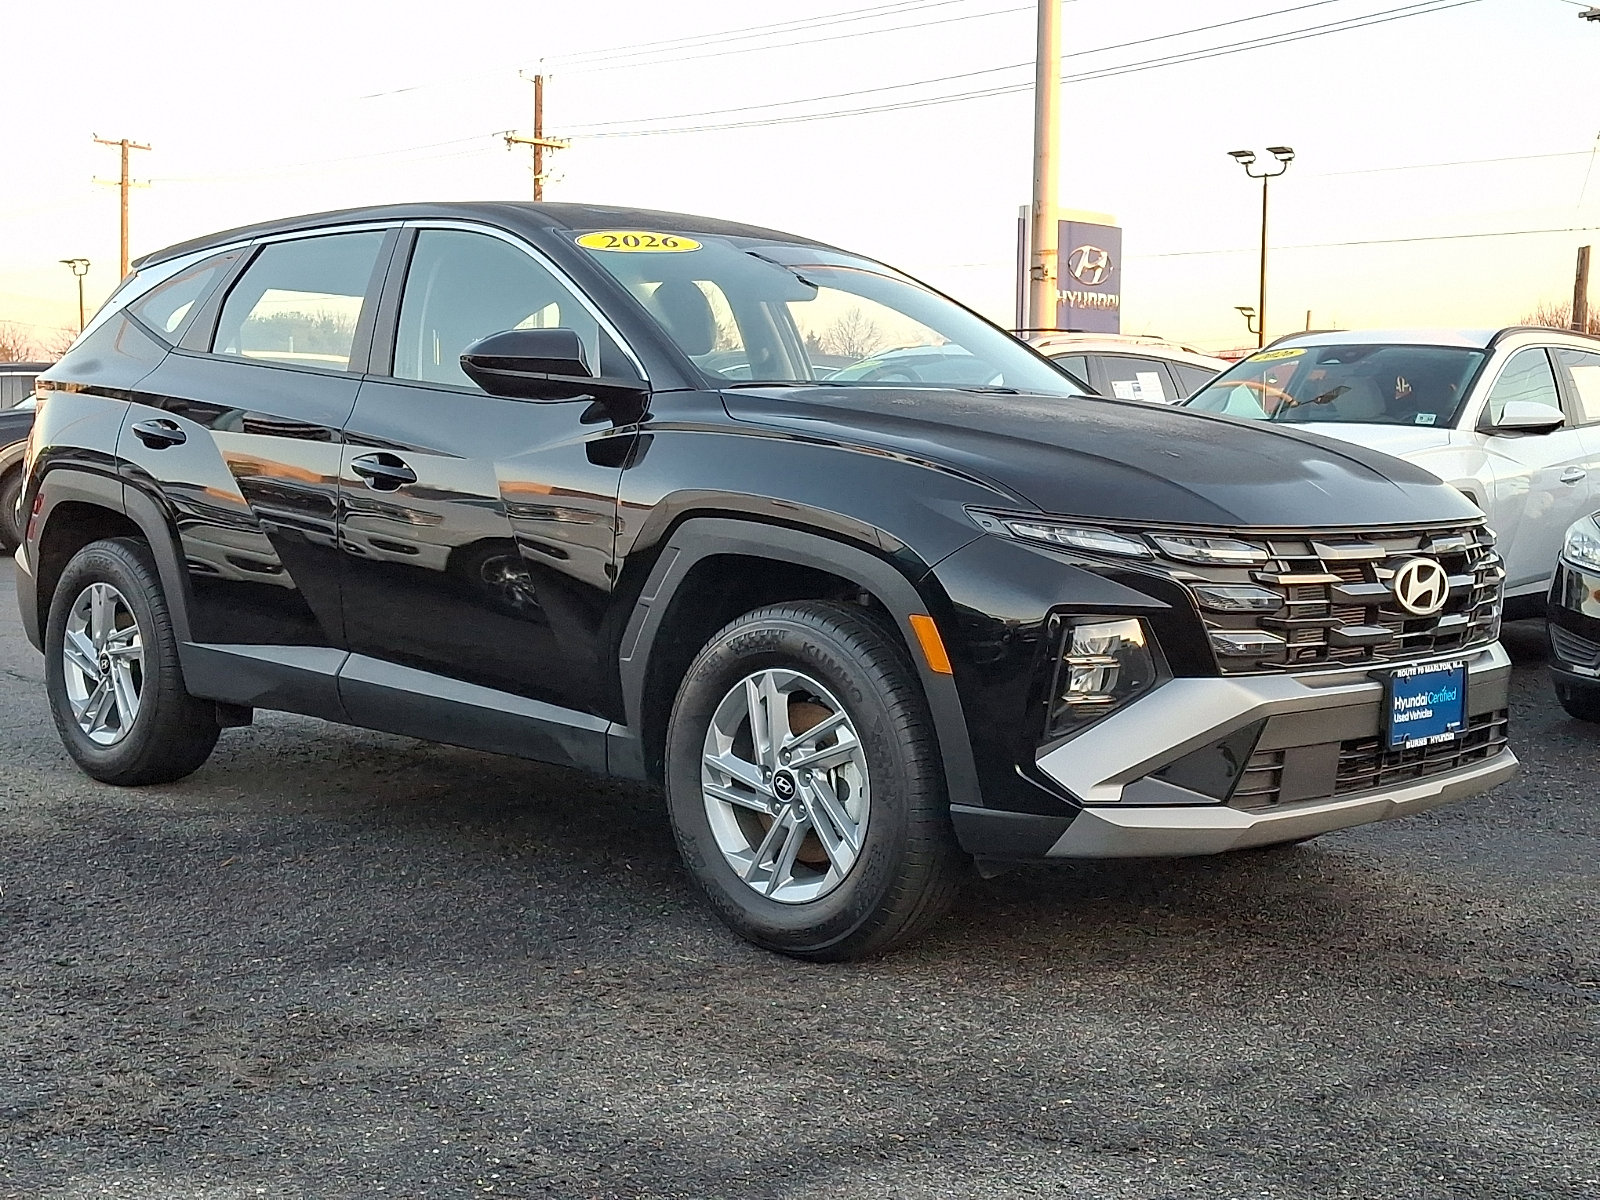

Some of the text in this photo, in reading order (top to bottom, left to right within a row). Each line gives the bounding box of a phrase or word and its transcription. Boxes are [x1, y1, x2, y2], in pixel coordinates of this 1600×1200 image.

[601, 235, 679, 248] 2026
[801, 641, 863, 703] KUMHO
[1397, 667, 1417, 678] ROUTE
[1394, 692, 1428, 712] Hyundai
[1394, 708, 1433, 723] Used Vehicles
